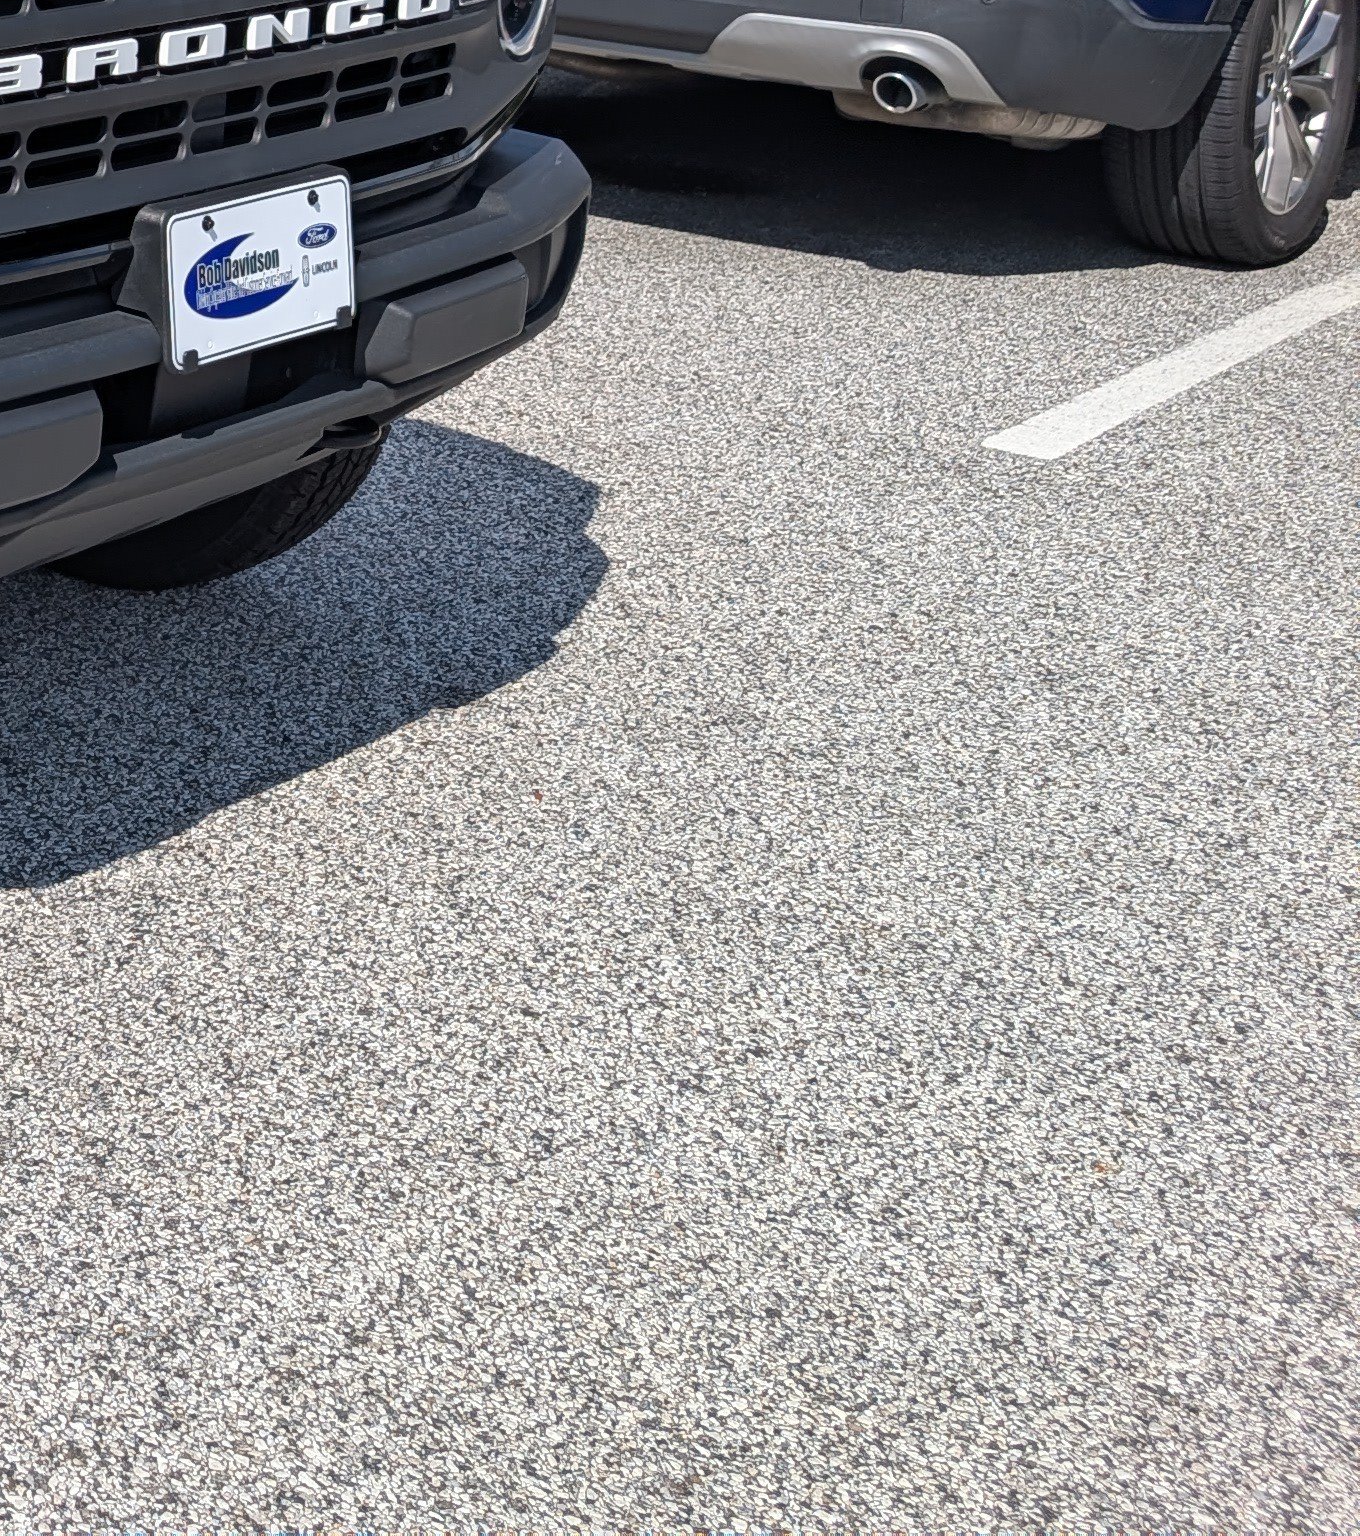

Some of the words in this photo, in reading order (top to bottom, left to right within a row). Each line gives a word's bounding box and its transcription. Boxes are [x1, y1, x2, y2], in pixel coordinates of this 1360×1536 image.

[197, 258, 222, 289] Bob
[223, 248, 281, 281] Davidson
[311, 259, 338, 276] LINCOLN
